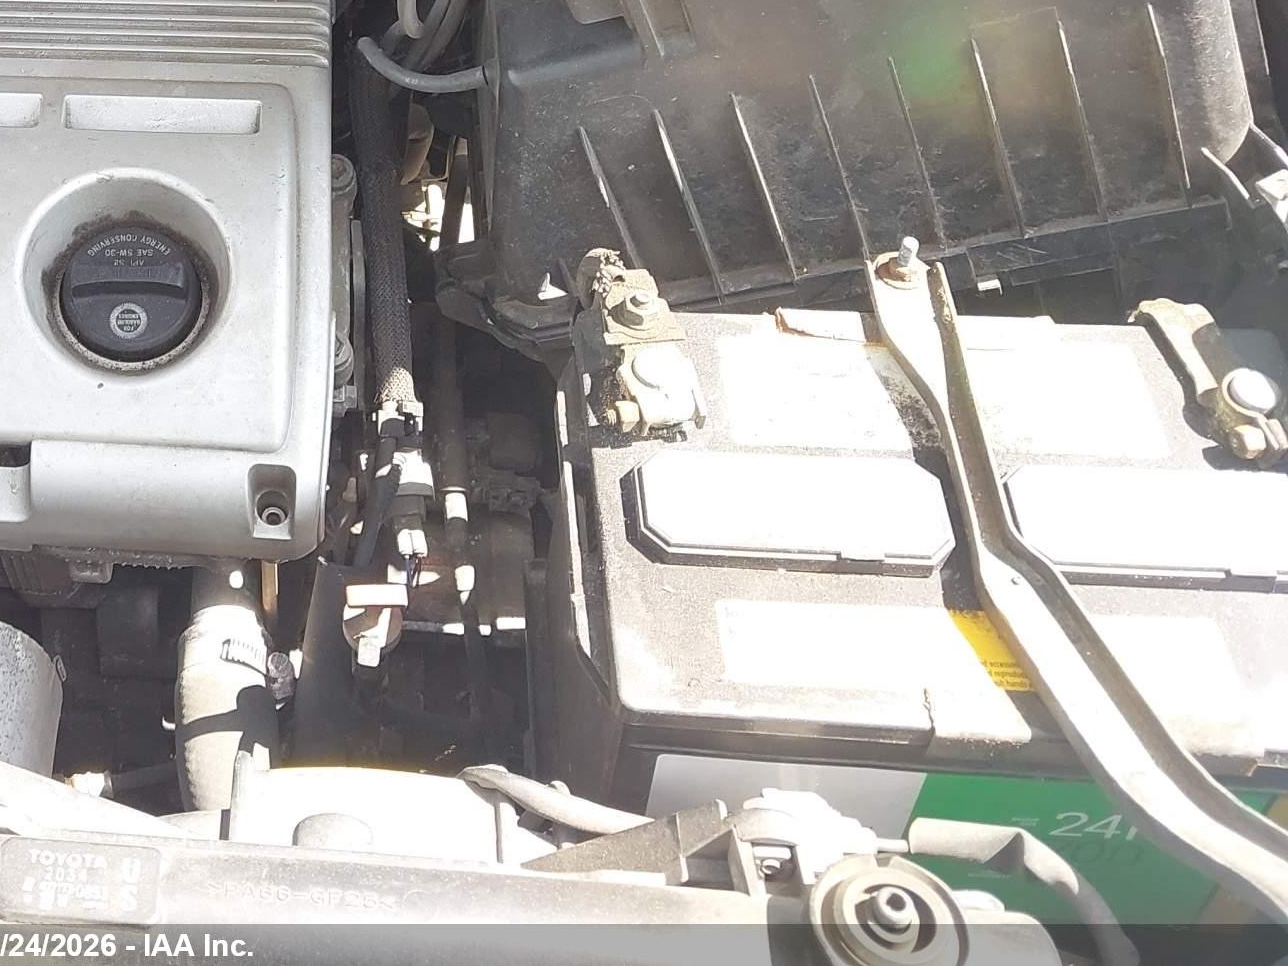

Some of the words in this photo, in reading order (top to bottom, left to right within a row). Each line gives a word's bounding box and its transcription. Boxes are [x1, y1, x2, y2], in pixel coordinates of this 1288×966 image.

[87, 233, 138, 257] CONSERVING
[105, 248, 133, 257] 5W-30
[137, 248, 154, 257] SAE
[140, 235, 171, 256] ENERGY
[29, 849, 108, 869] TOYOTA
